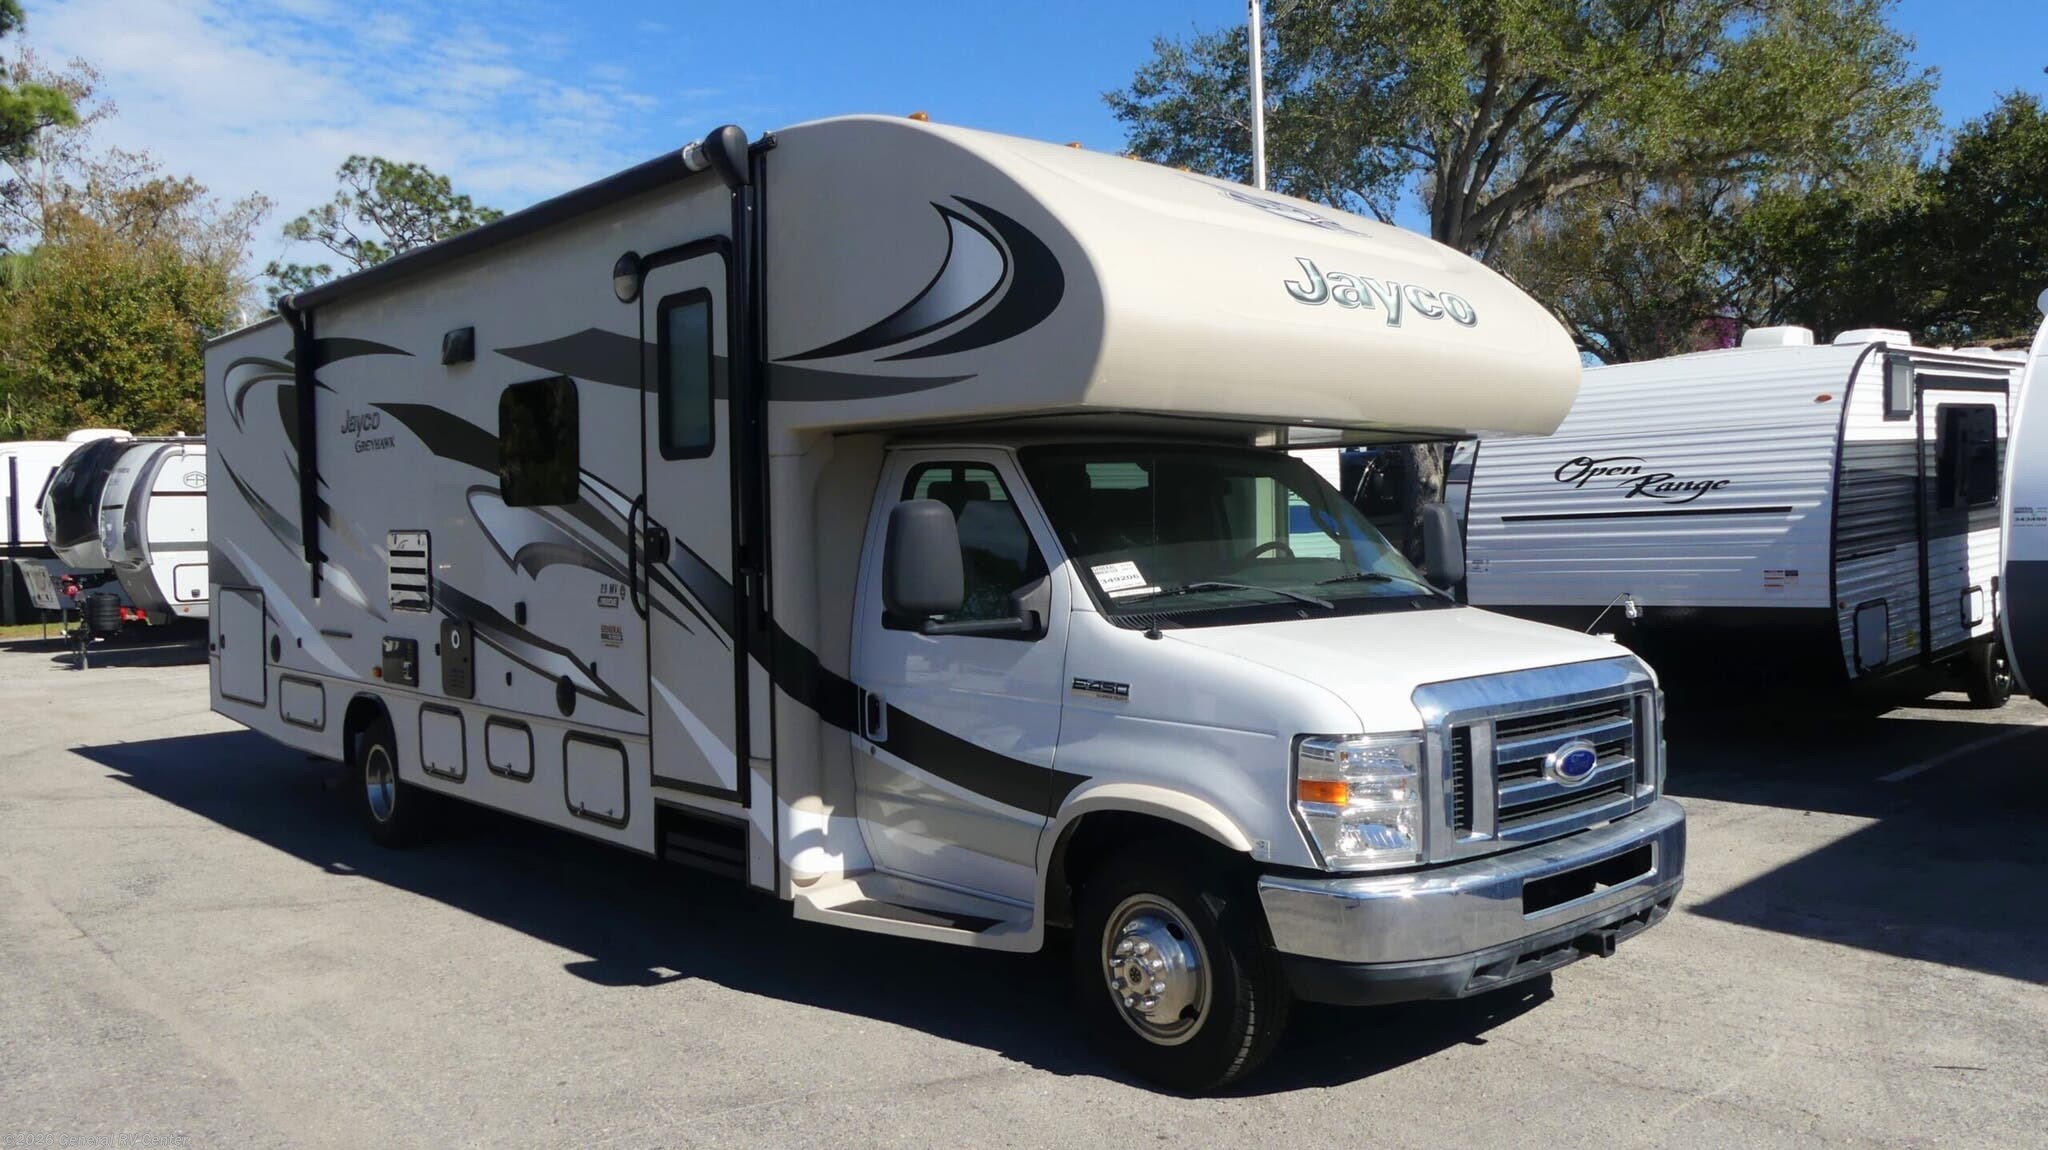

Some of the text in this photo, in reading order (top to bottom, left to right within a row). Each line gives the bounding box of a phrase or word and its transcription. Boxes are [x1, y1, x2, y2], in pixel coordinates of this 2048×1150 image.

[1283, 257, 1478, 328] Jayco
[341, 409, 380, 438] Jayco
[1554, 456, 1648, 488] Open
[1616, 473, 1730, 504] Range
